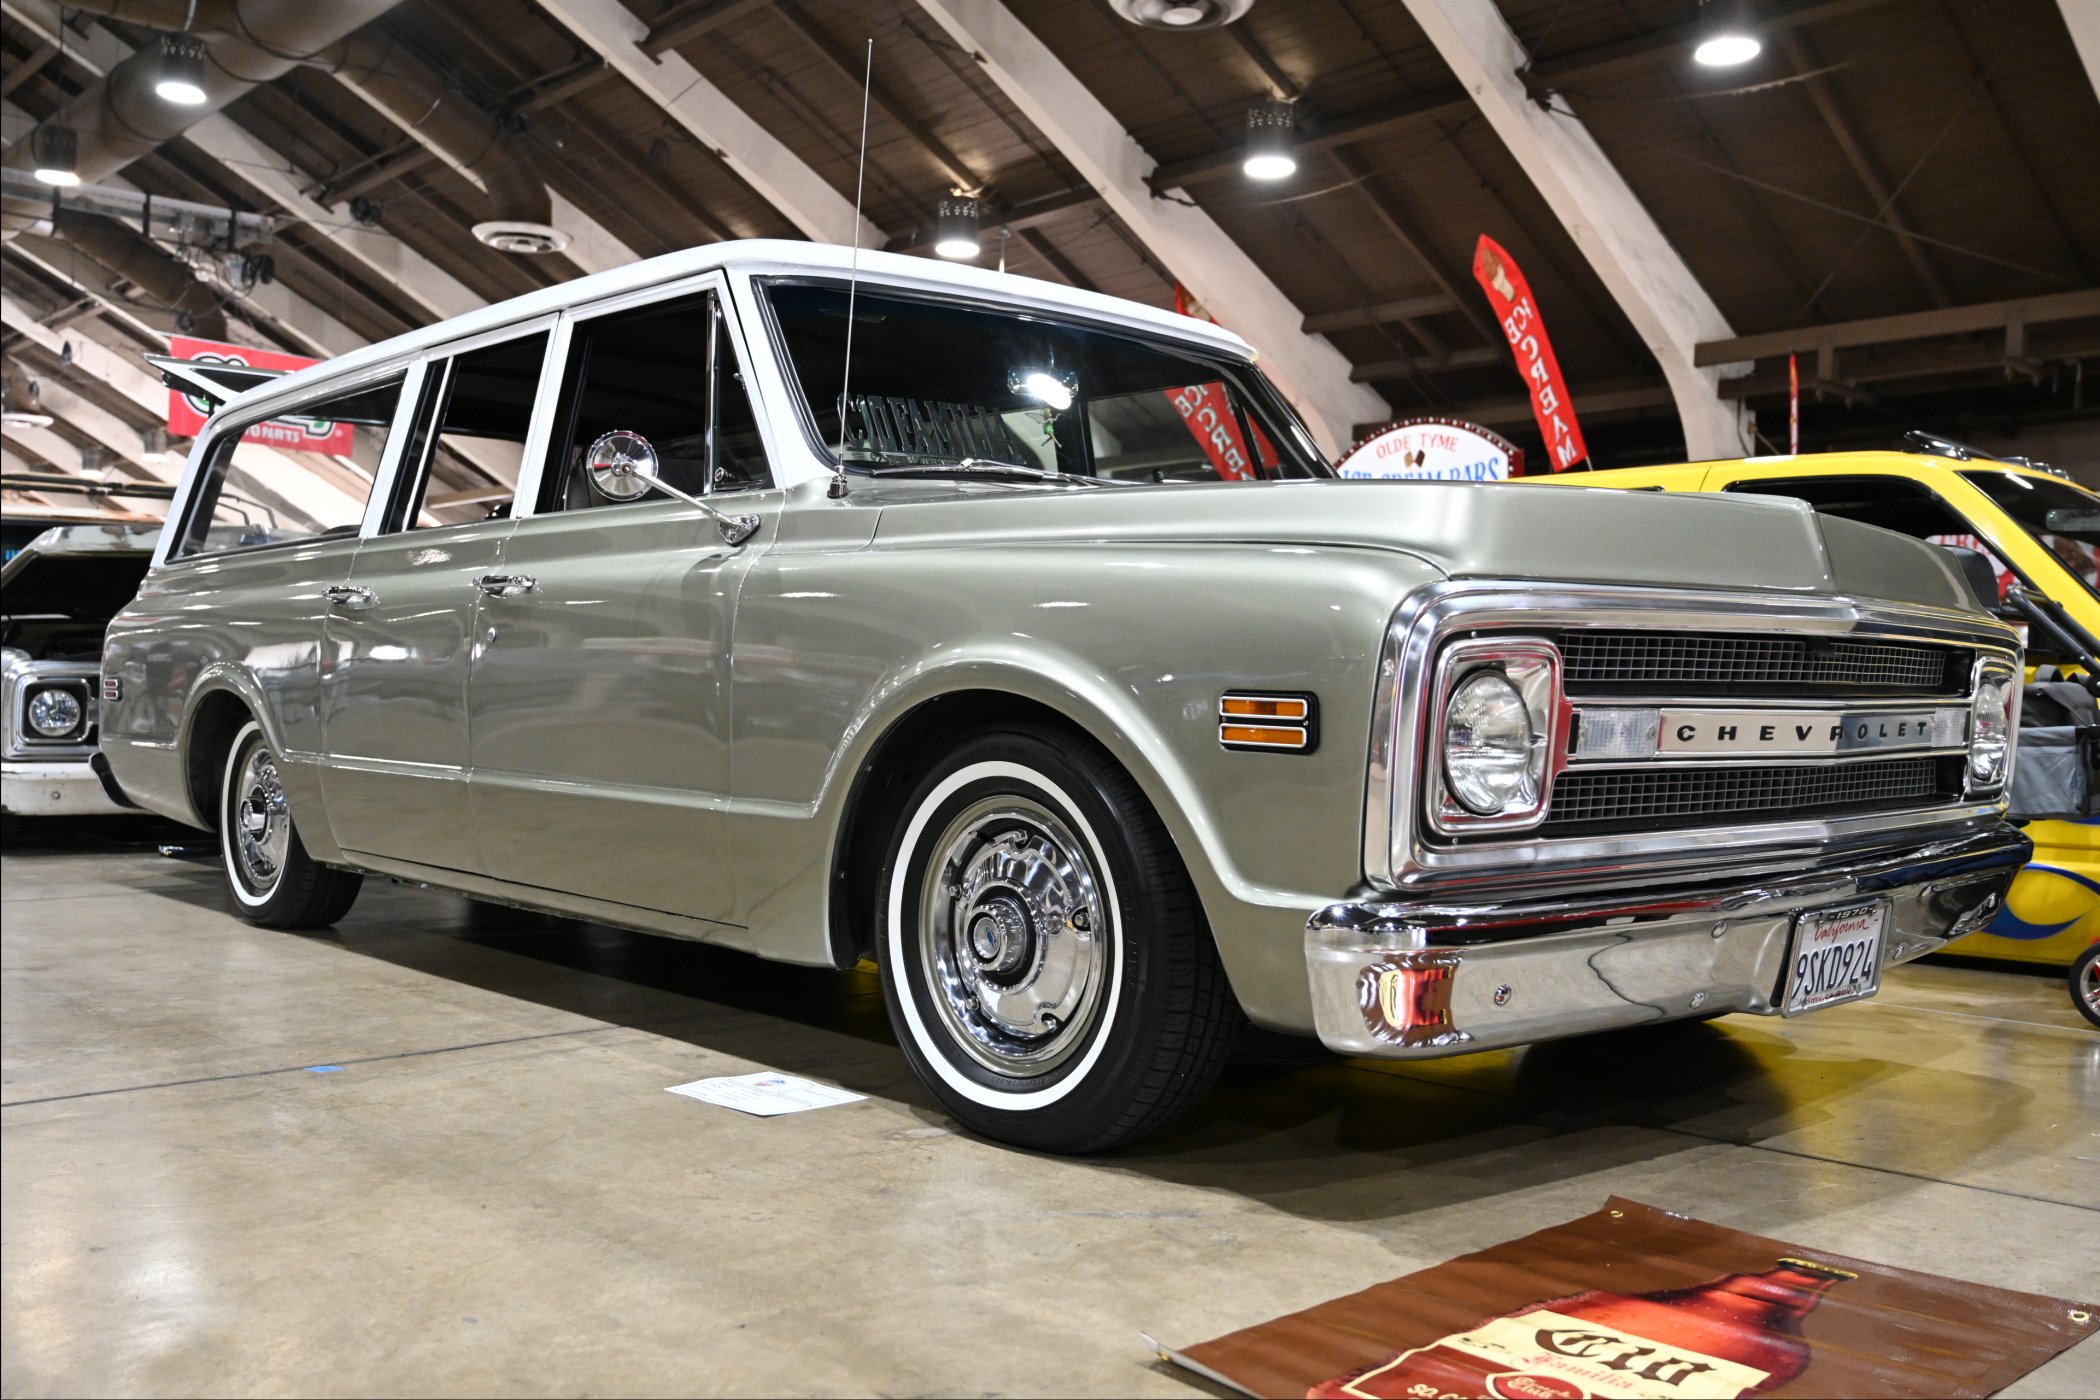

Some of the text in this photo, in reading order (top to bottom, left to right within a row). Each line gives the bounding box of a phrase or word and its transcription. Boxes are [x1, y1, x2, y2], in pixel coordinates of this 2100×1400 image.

[262, 426, 300, 443] PARTS
[1376, 432, 1460, 459] OLDE TYME
[1676, 721, 1927, 742] CHEVROLET
[1792, 938, 1874, 999] 9SKD924
